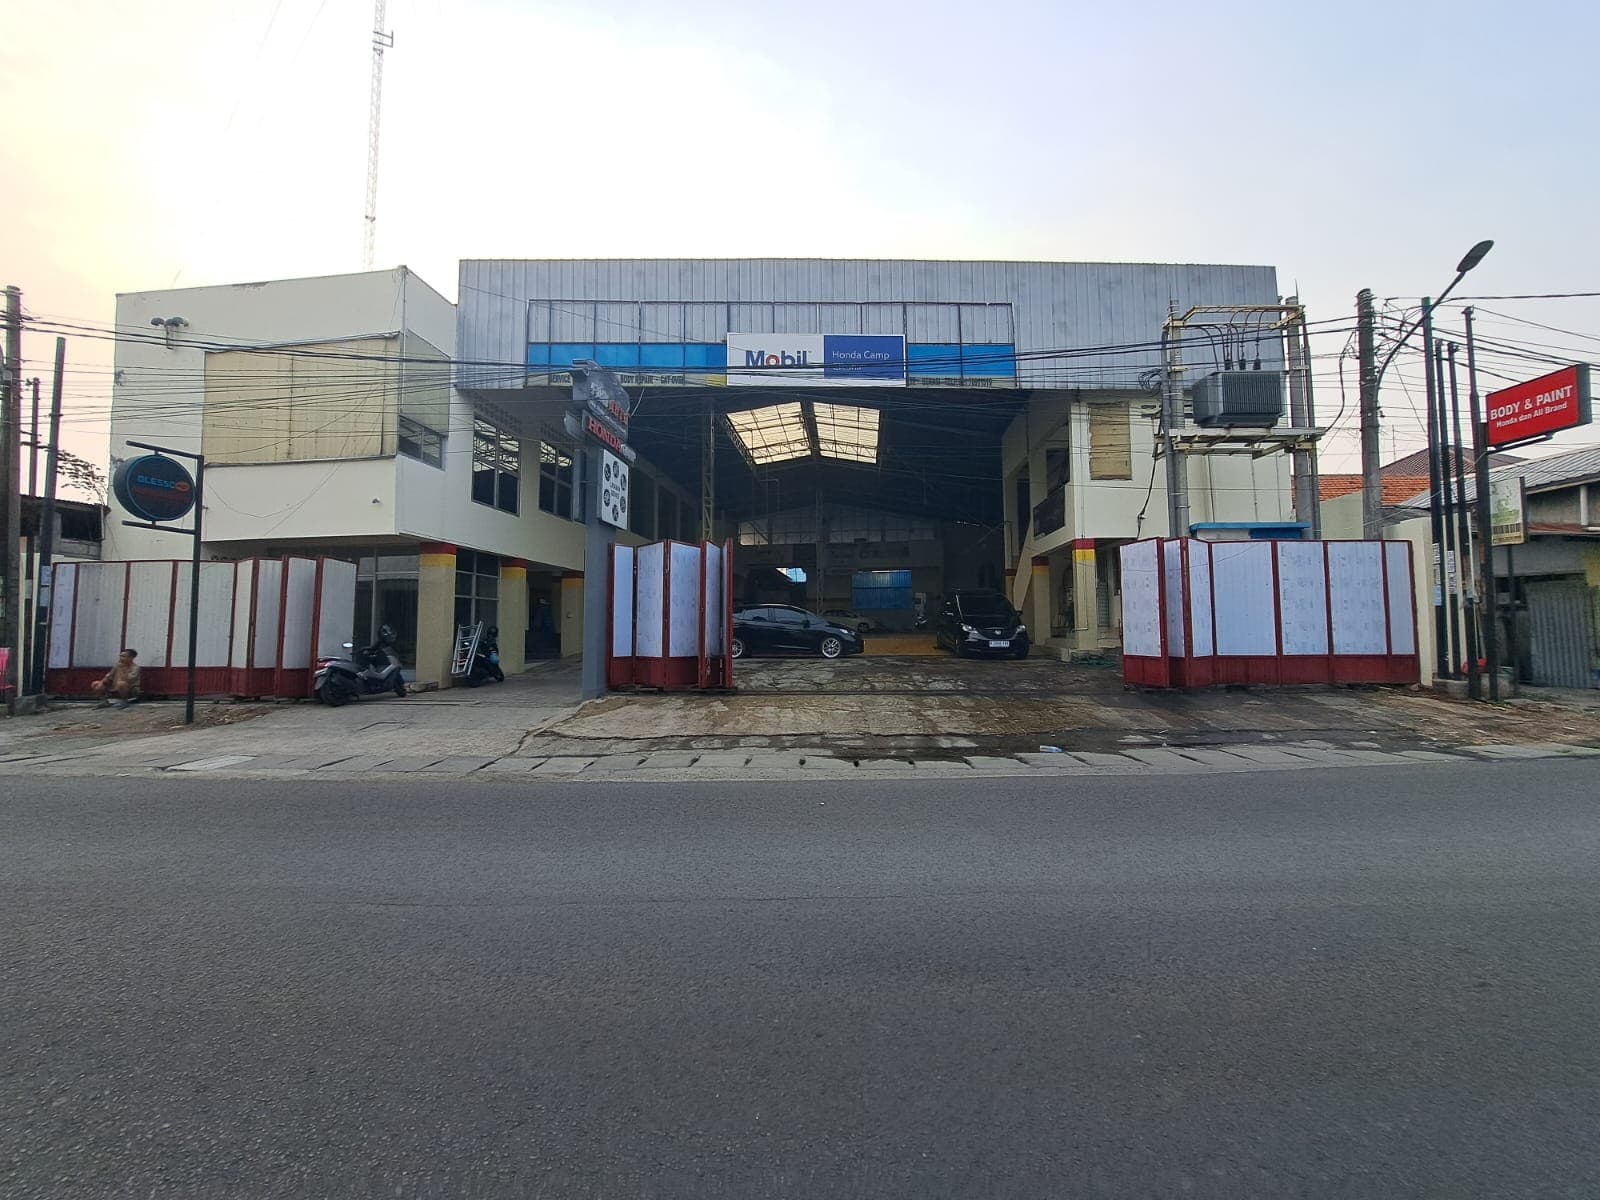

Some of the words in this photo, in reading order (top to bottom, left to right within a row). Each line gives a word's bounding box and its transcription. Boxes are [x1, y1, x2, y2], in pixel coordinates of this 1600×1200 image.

[745, 350, 808, 367] Mobil
[832, 350, 861, 360] Honda
[863, 350, 890, 361] Camp
[1490, 401, 1520, 421] BODY
[1524, 398, 1533, 410] &
[1536, 385, 1573, 407] PAINT
[1496, 416, 1518, 428] Honda
[1519, 412, 1532, 422] dan
[1533, 408, 1544, 418] All
[1544, 401, 1568, 414] Brand
[588, 415, 622, 454] HONDA
